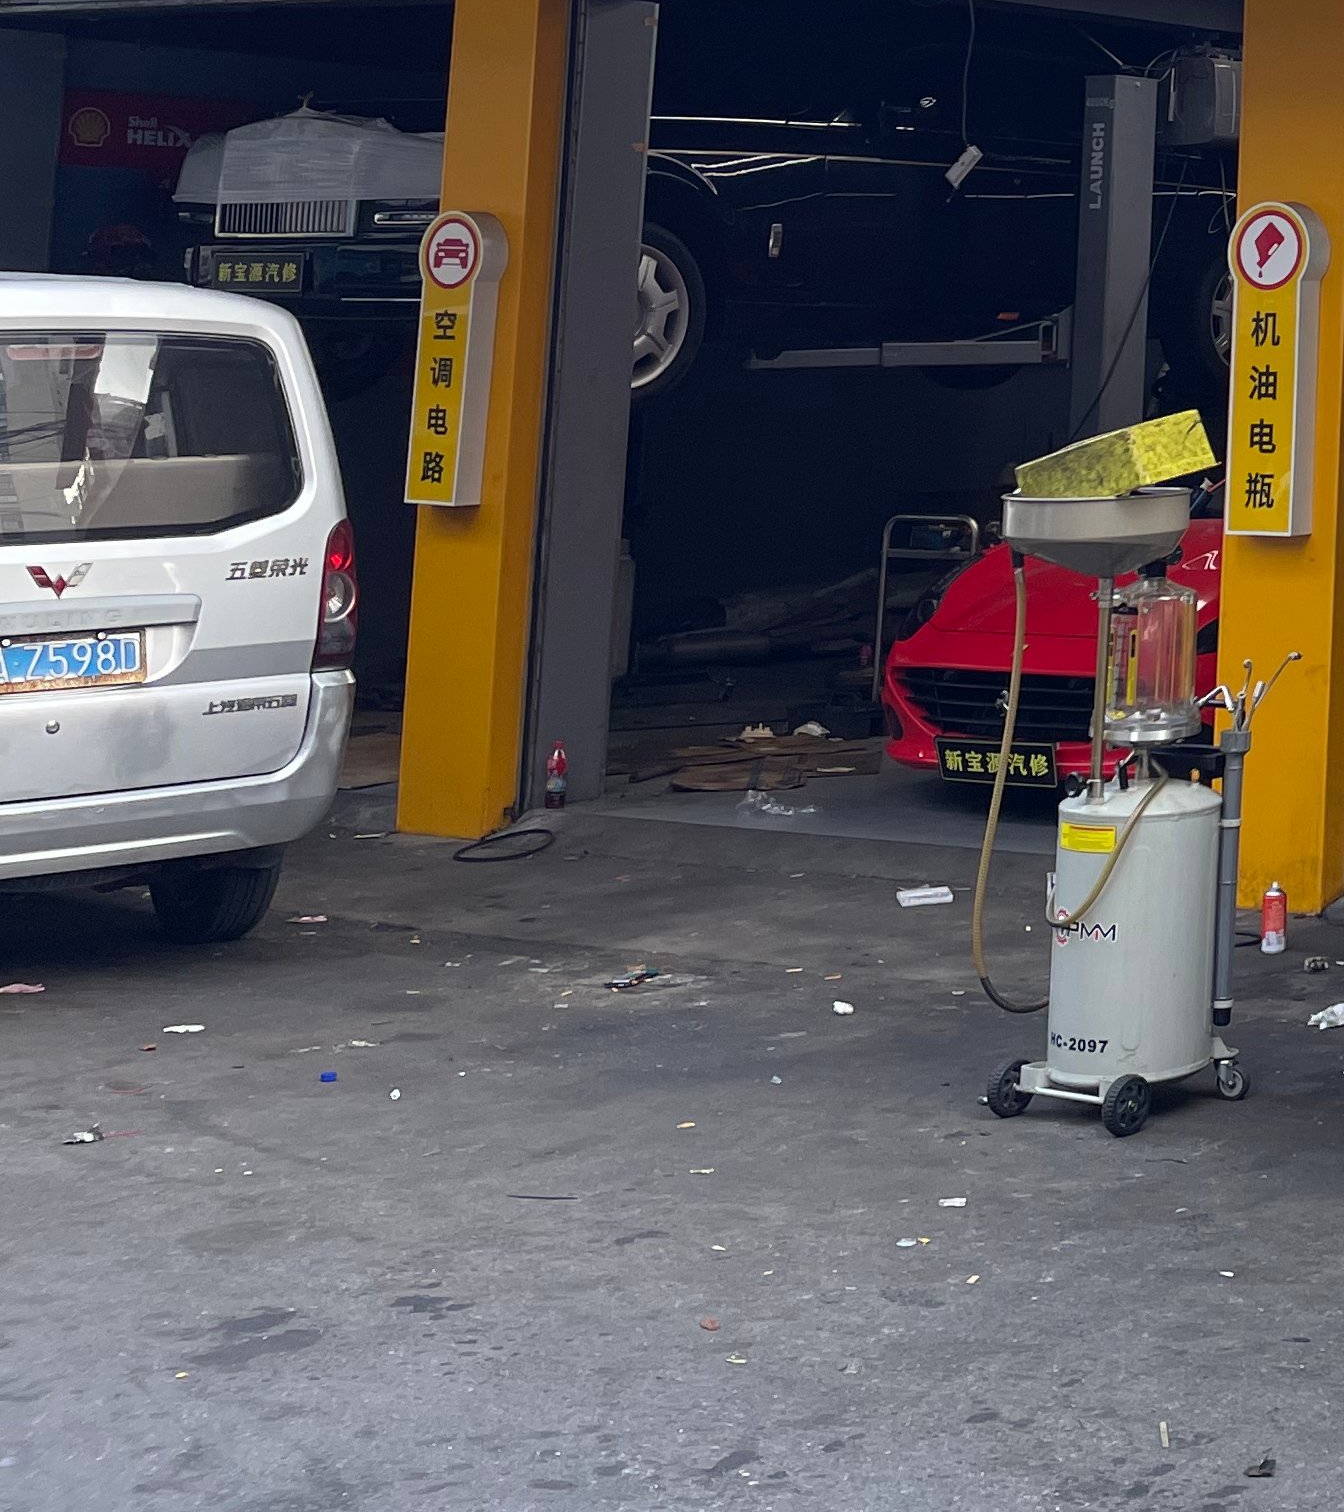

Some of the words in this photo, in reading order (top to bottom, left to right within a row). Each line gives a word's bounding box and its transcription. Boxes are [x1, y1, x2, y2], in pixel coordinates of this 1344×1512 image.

[127, 125, 192, 148] HELIX
[1089, 123, 1105, 209] LAUNCH
[218, 262, 297, 282] 新宝源汽修
[421, 310, 457, 484] 空调电路
[1245, 311, 1281, 509] 机油电瓶
[225, 557, 309, 581] 五菱荣光
[944, 749, 1049, 776] 新宝源汽修
[1050, 1031, 1108, 1053] HC-2097
